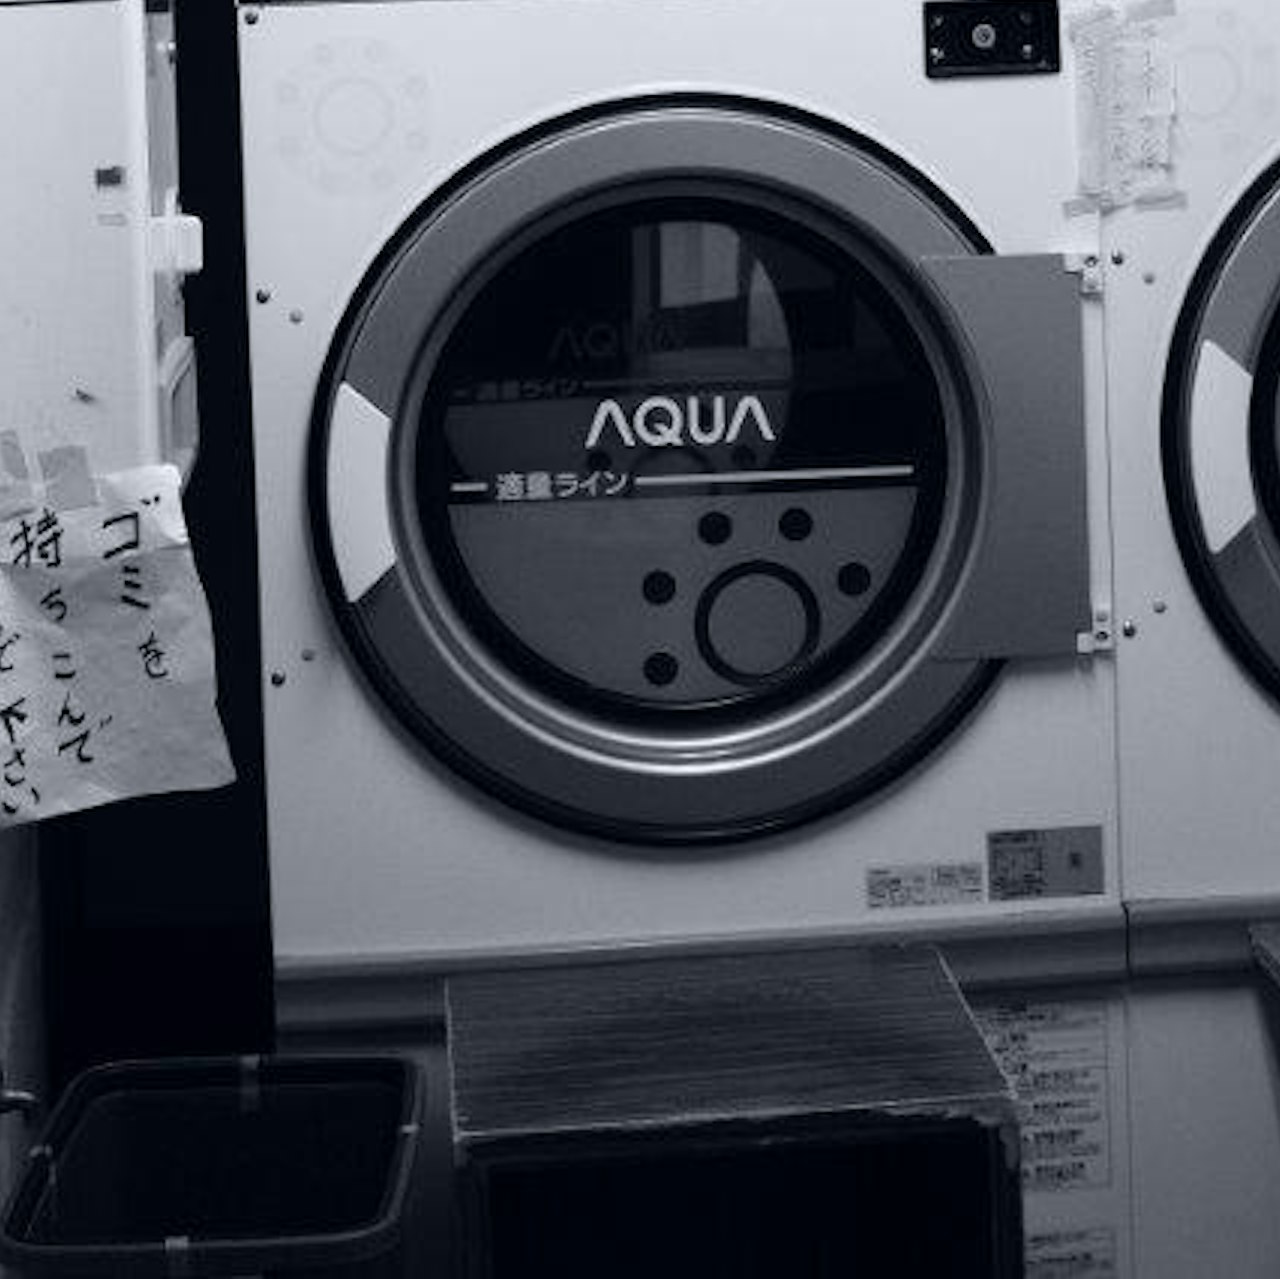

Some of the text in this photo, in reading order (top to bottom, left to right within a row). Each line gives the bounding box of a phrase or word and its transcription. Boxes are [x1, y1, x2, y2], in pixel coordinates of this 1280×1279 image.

[584, 394, 777, 450] AQUA
[494, 470, 630, 503] 適量ライン
